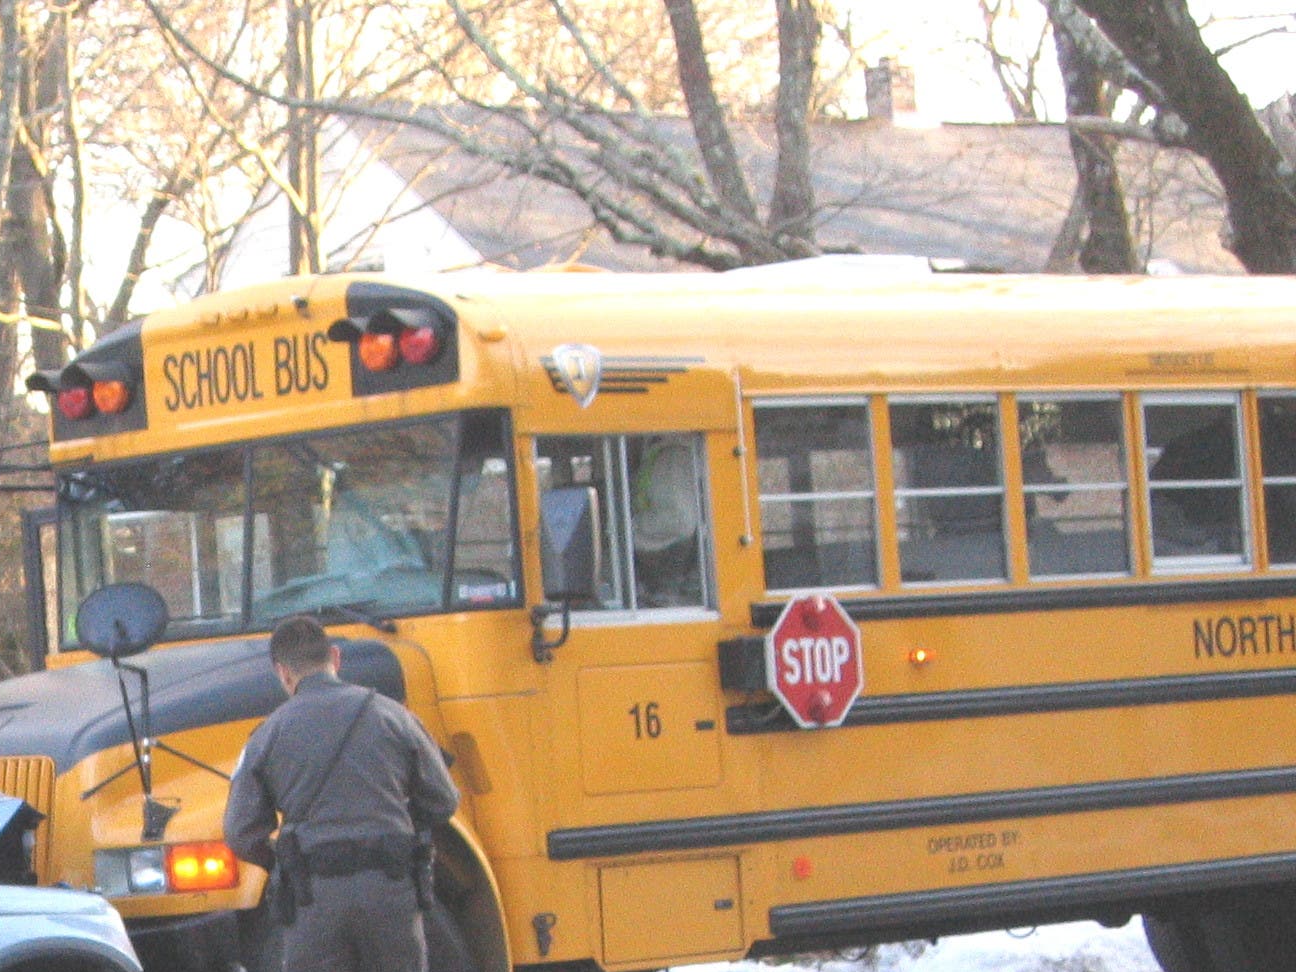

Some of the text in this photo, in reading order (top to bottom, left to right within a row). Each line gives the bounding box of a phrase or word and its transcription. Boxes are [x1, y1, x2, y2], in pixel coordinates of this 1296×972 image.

[163, 333, 329, 412] SCHOOL BUS
[1193, 614, 1296, 659] NORTH
[782, 636, 850, 684] STOP
[629, 702, 661, 739] 16
[927, 832, 997, 854] OPERATED
